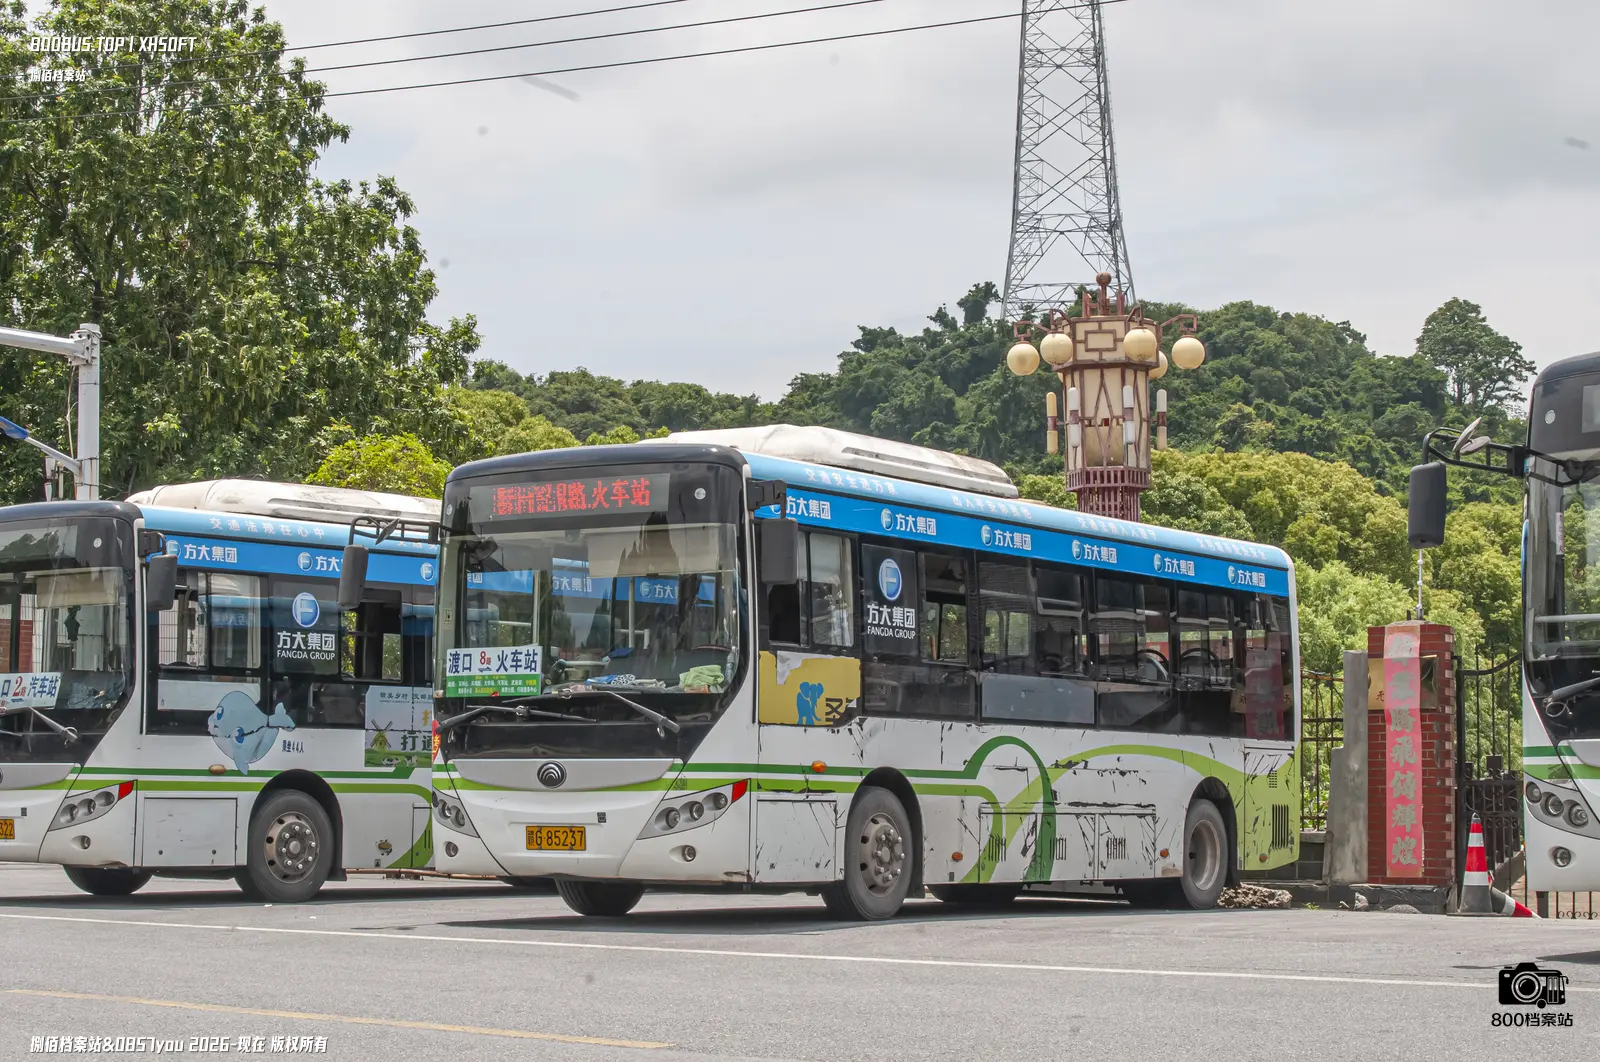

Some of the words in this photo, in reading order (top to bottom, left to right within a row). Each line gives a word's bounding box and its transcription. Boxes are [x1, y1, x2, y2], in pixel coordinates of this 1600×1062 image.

[785, 496, 831, 520] 方大集团
[209, 517, 325, 539] 交通法规在心中
[895, 513, 937, 536] 方大集团
[994, 529, 1032, 551] 方大集团
[183, 544, 238, 563] 方大集团
[315, 556, 342, 572] 方大
[1083, 543, 1117, 564] 方大集团
[1163, 557, 1195, 577] 方大集团
[1237, 569, 1266, 588] 方大集团
[867, 603, 916, 629] 方大集团
[277, 630, 336, 651] 方大集团
[867, 625, 894, 637] FANGDA
[894, 628, 916, 640] GROUP
[276, 649, 309, 660] FANGDA
[309, 651, 336, 661] GROUP
[448, 651, 473, 674] 渡口
[496, 649, 538, 673] 火车站
[28, 675, 60, 698] 汽车站
